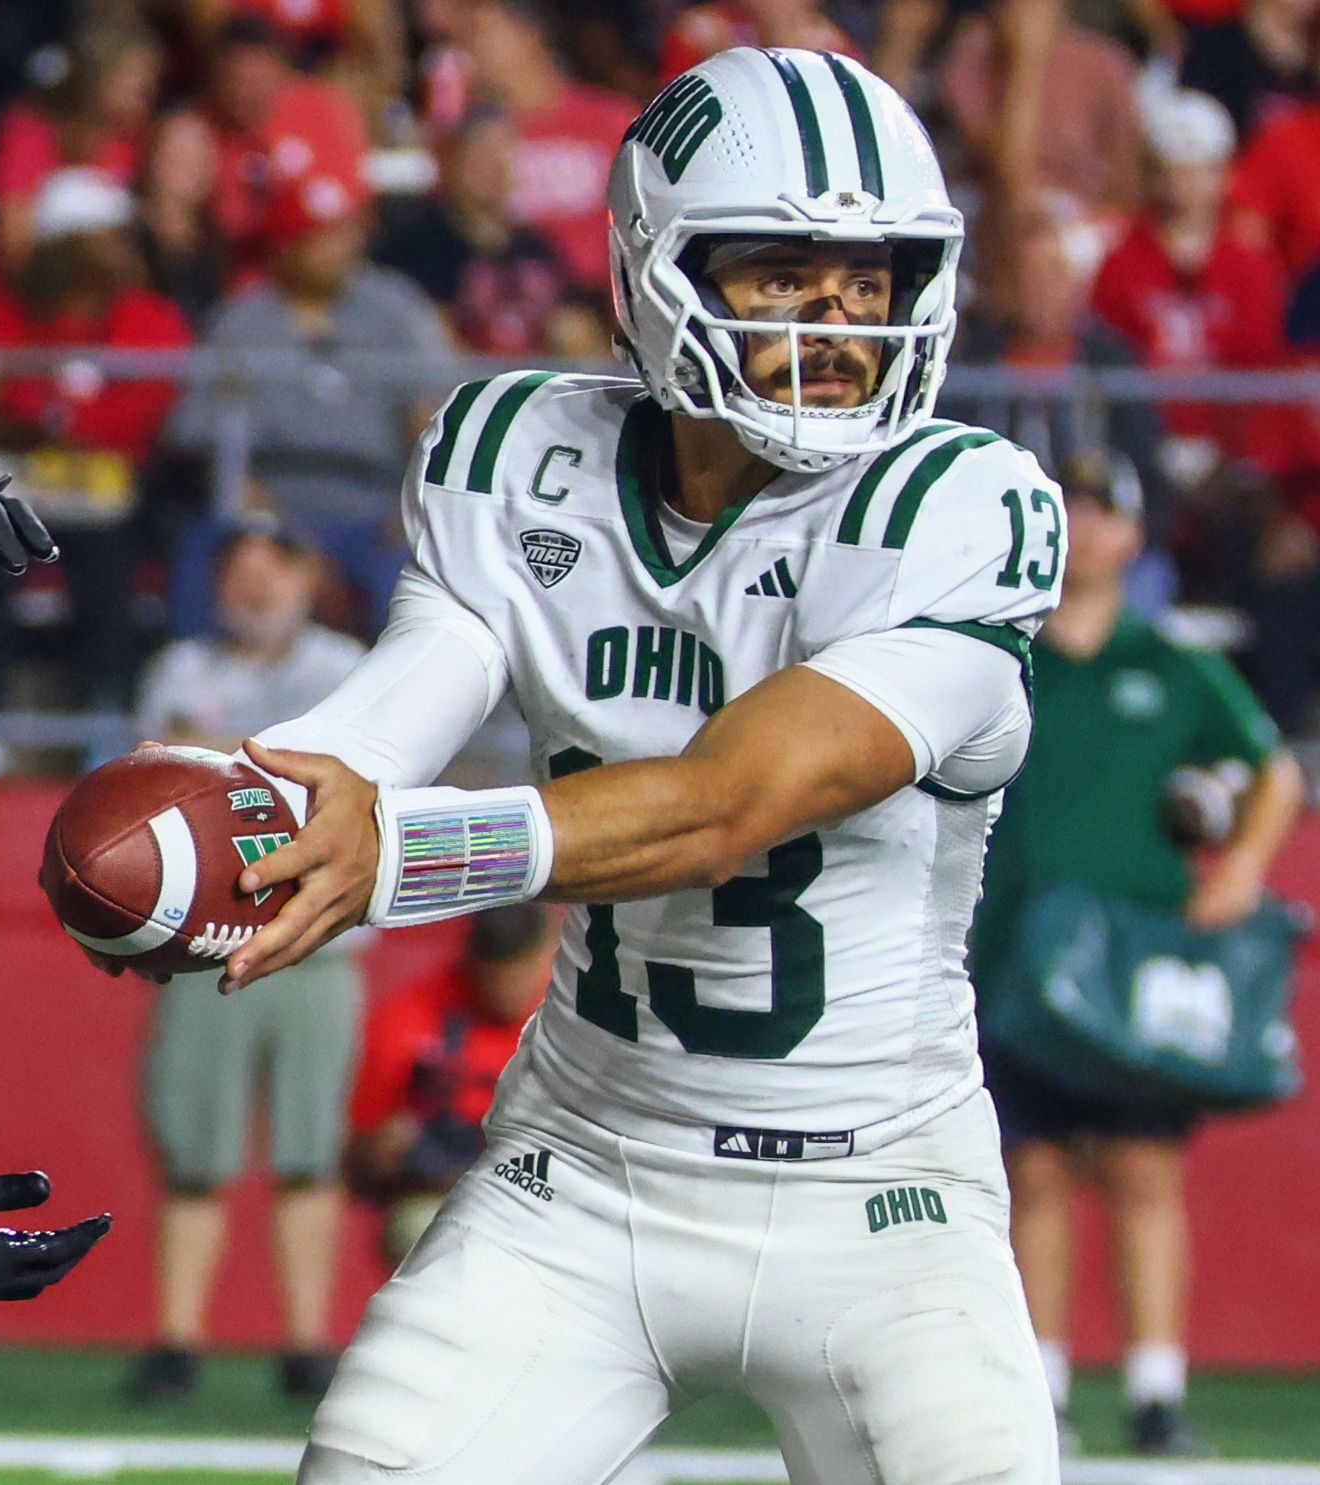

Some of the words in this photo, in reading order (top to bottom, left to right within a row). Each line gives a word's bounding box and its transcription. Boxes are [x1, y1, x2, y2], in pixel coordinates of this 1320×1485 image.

[527, 444, 584, 507] C
[526, 544, 577, 567] MAC
[995, 487, 1062, 592] 13
[585, 625, 726, 718] OHIO
[229, 789, 273, 808] DIME
[547, 744, 826, 1060] 13
[776, 1140, 788, 1155] M
[494, 1162, 555, 1202] adidas
[864, 1186, 948, 1234] OHIO
